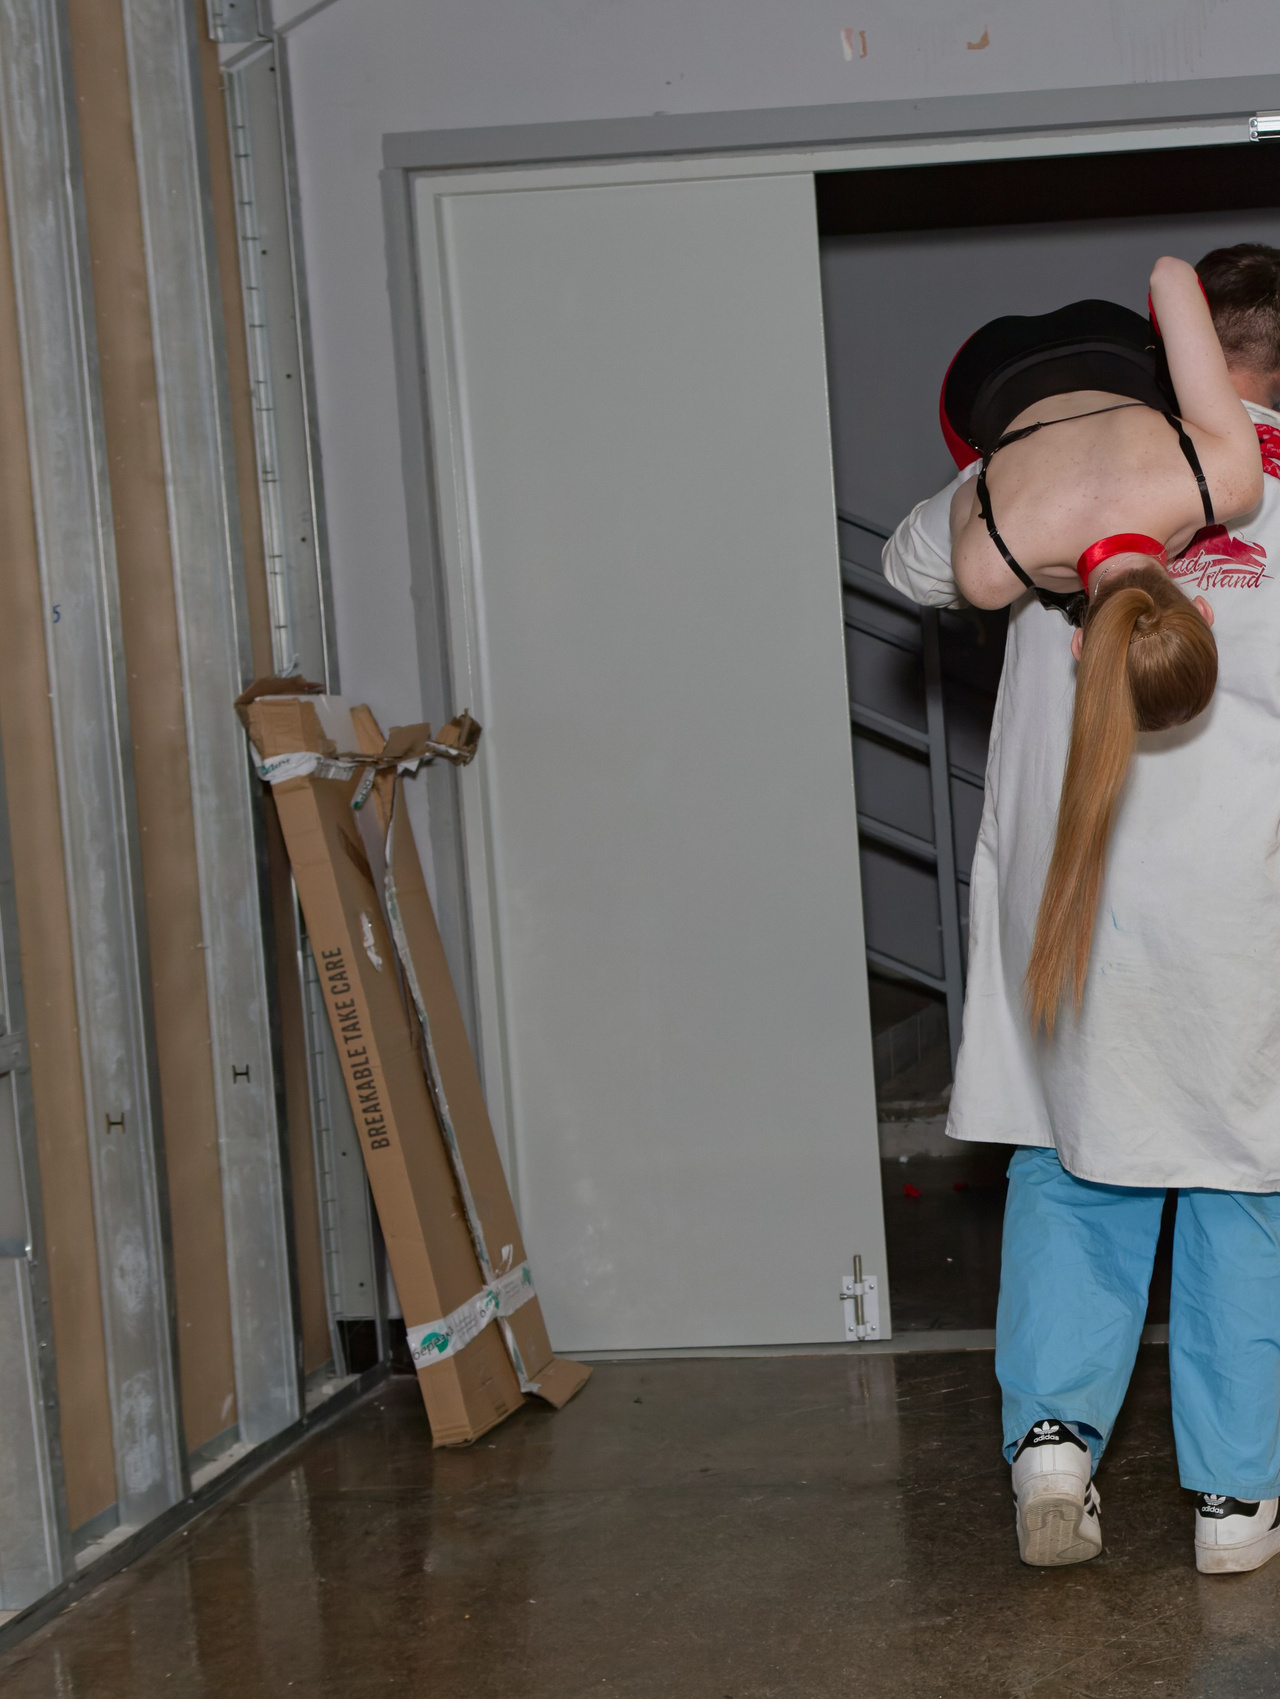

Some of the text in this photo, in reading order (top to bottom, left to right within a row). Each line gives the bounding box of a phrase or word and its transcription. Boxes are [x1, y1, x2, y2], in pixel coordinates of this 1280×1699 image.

[1168, 550, 1211, 575] ady
[1196, 561, 1264, 591] Island
[322, 947, 391, 1150] BREAKABLE TAKE CARE
[1033, 1434, 1060, 1443] adidas
[1201, 1505, 1224, 1515] adidas
